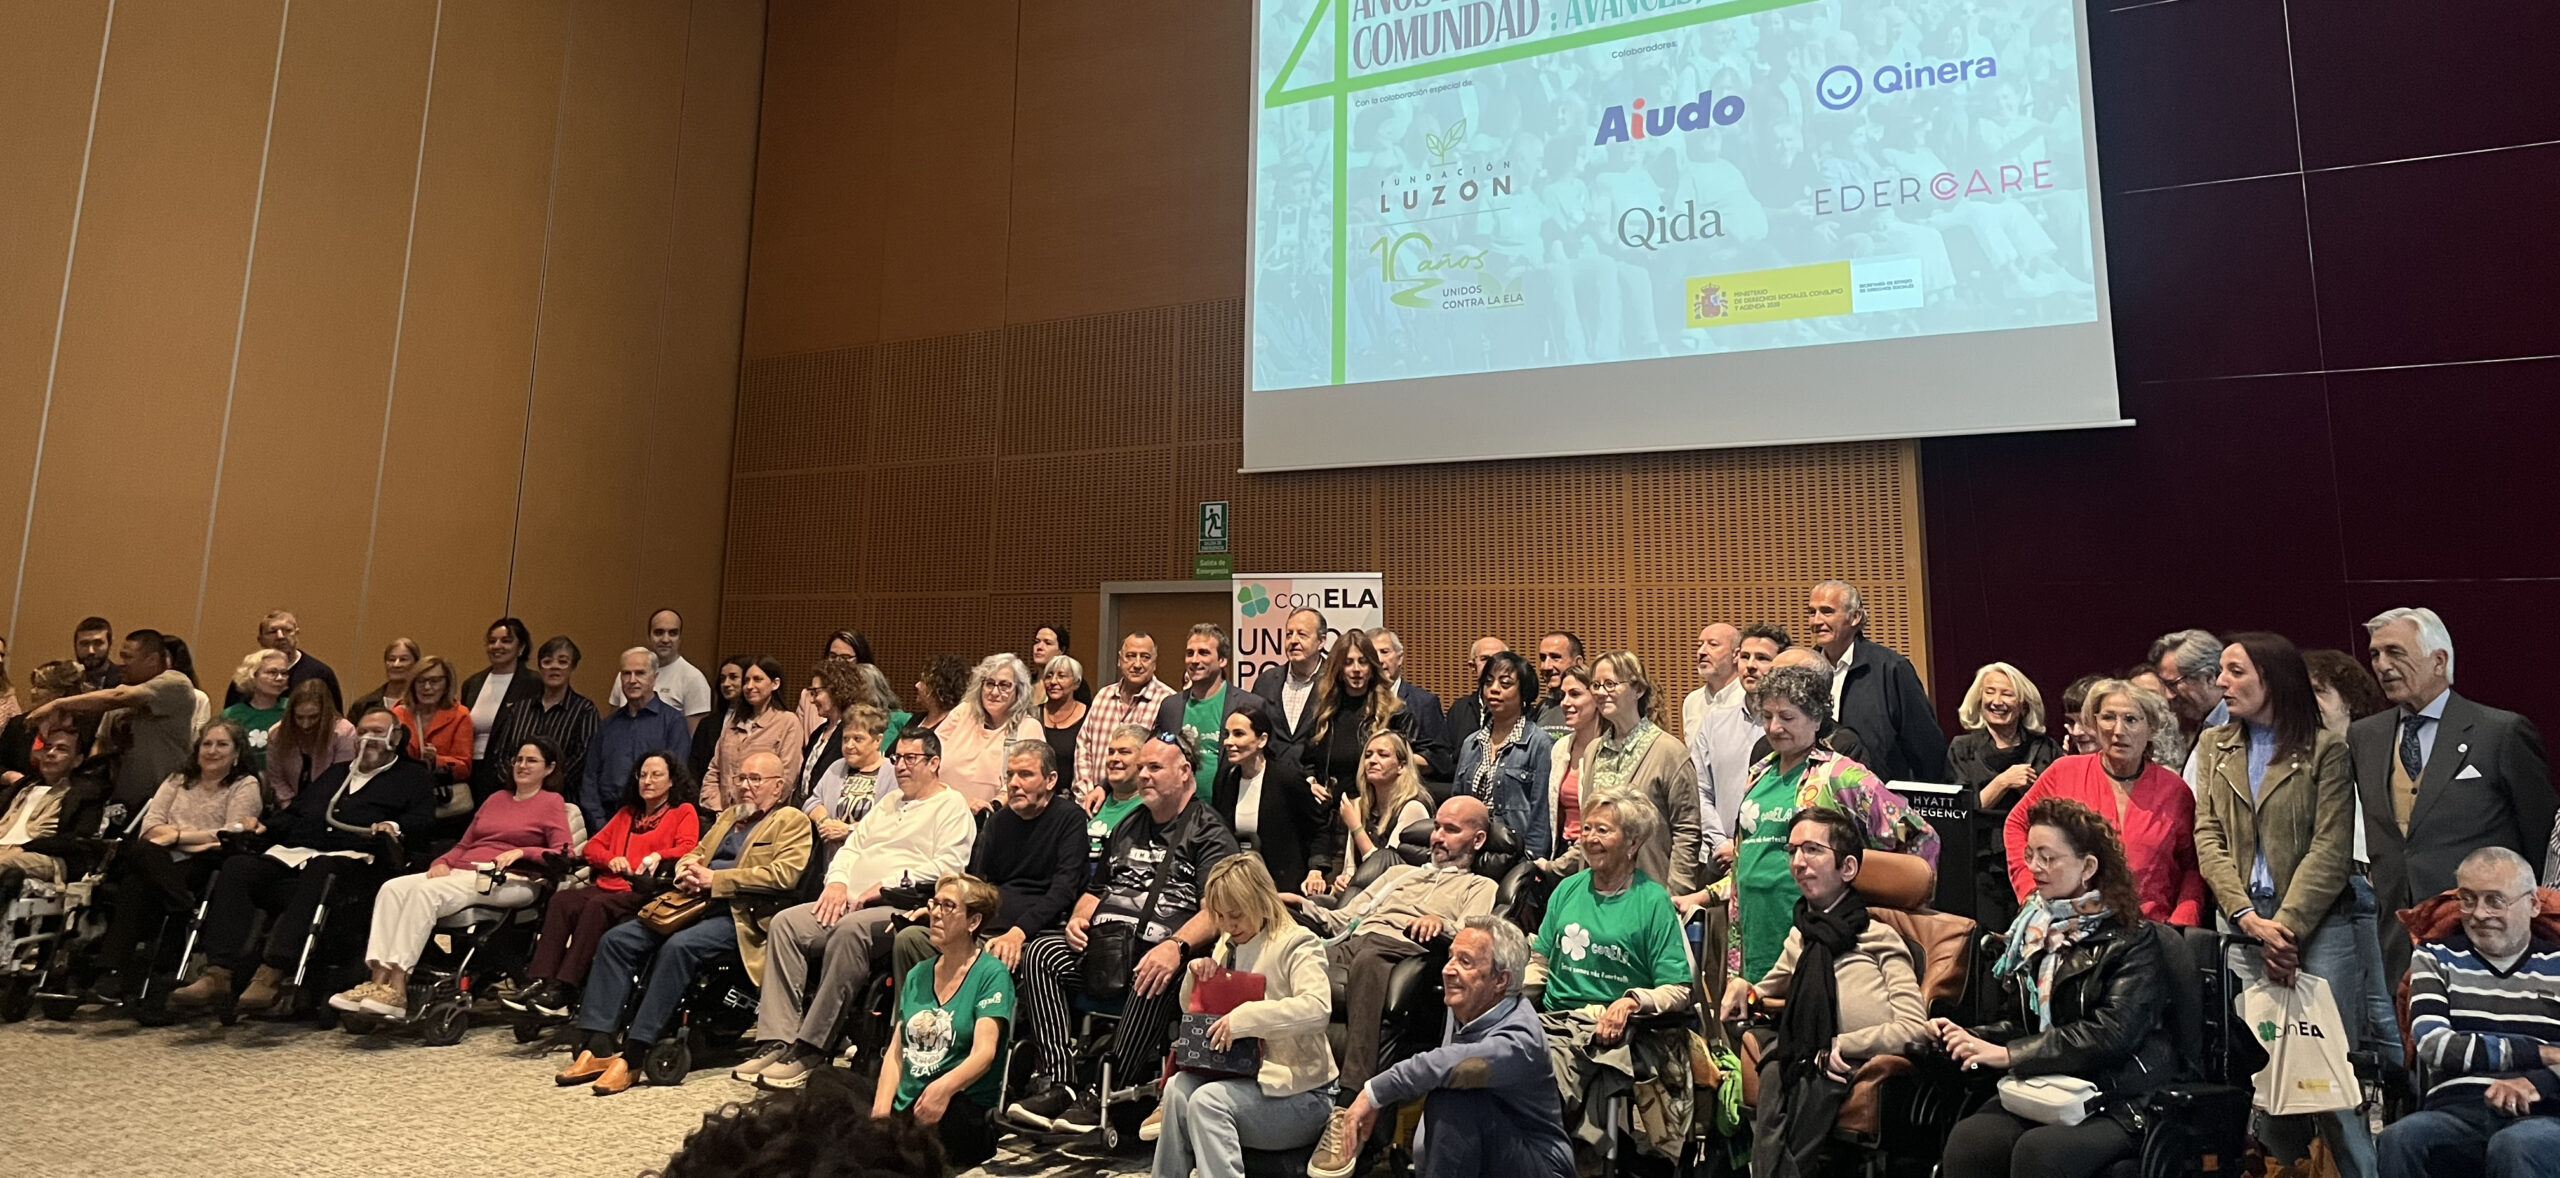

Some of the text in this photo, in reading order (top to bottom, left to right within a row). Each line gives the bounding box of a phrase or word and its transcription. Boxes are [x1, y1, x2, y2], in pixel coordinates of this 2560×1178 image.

[1353, 0, 1540, 70] COMUNIDAD
[1873, 56, 1998, 95] Qinera
[1355, 99, 1370, 107] Con
[1594, 90, 1745, 146] Aiudo
[1381, 161, 1511, 188] FUNDACIÓN
[1617, 200, 1726, 251] Qida
[1418, 250, 1489, 272] años
[1442, 285, 1483, 297] UNIDOS
[1442, 293, 1524, 310] CONTRA LA ELA
[1274, 588, 1379, 609] conELA
[1913, 795, 1955, 808] HYATT
